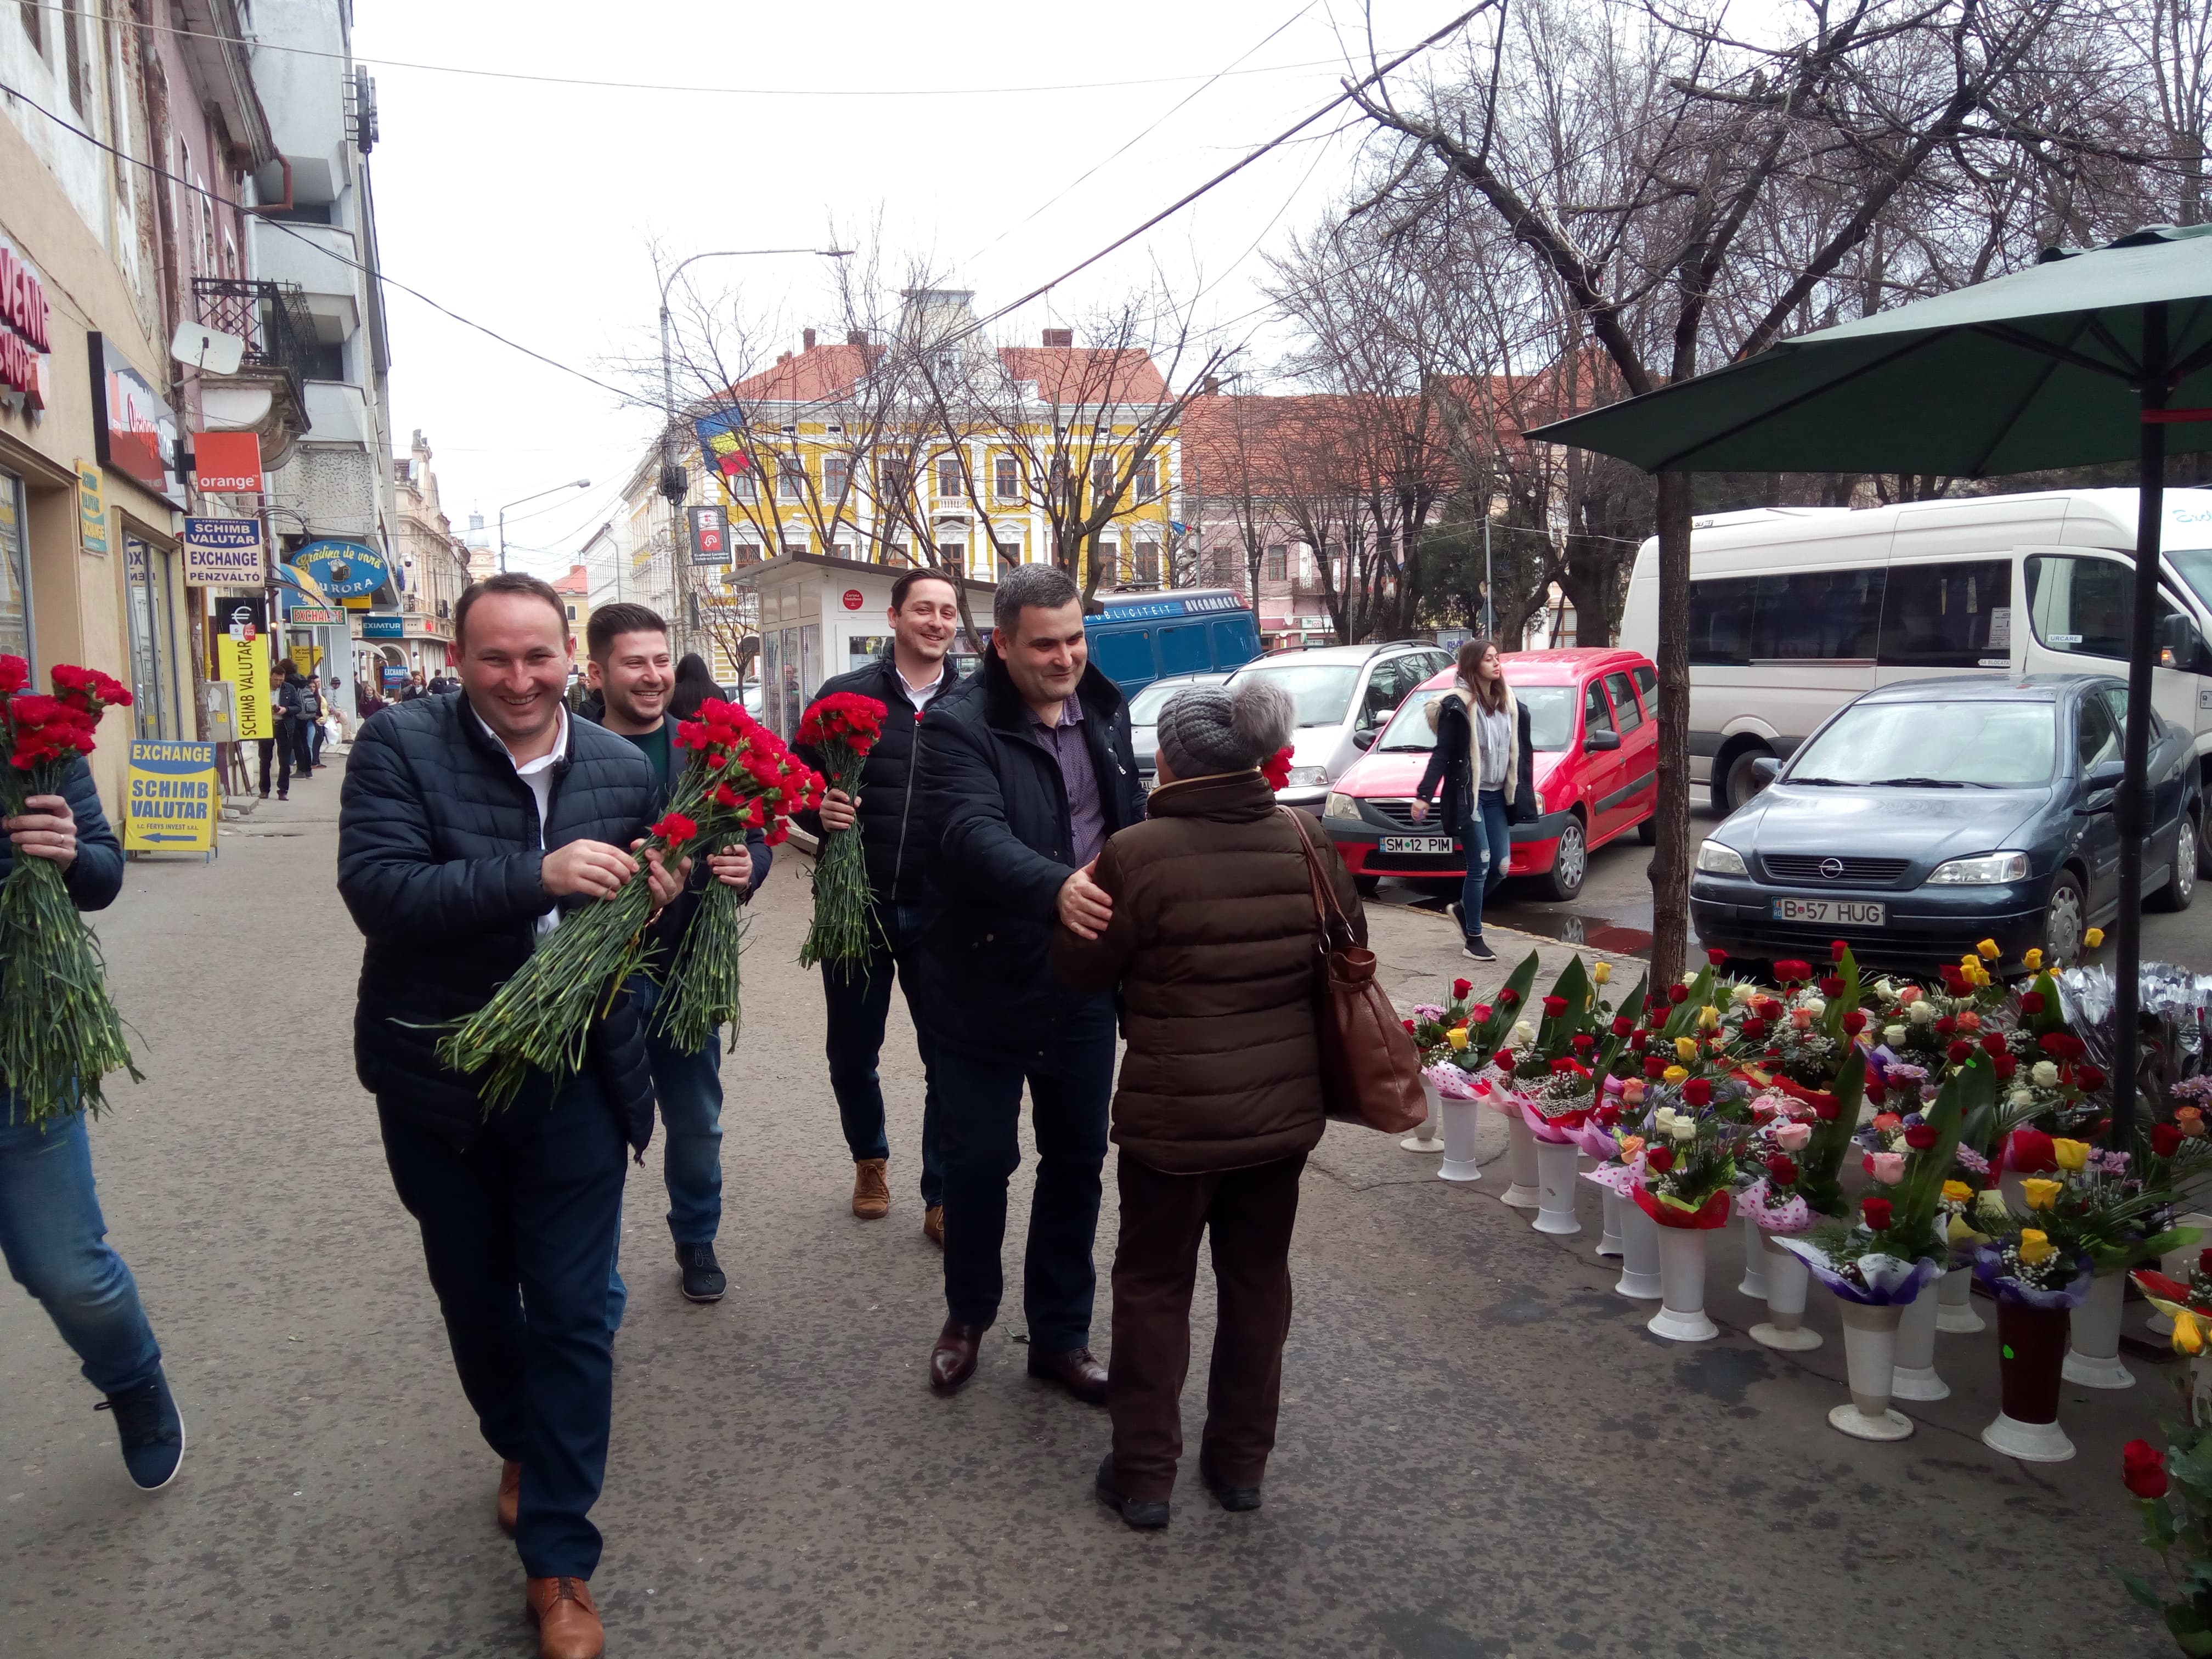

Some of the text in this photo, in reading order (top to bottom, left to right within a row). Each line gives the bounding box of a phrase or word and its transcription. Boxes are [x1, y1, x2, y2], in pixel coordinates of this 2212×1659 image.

[127, 393, 157, 460] Orange
[200, 476, 255, 489] orange
[195, 523, 250, 534] SCHIMB
[190, 534, 255, 544] VALUTAR
[190, 551, 258, 566] EXCHANGE
[343, 545, 354, 559] de
[190, 571, 260, 582] PÉNZVÁLTÓ
[318, 578, 374, 593] URORA
[294, 610, 343, 623] EXCHANE
[237, 640, 255, 691] VALUTAR
[240, 695, 257, 735] SCHIMB
[133, 744, 212, 763] EXCHANGE
[132, 779, 208, 799] SCHIMB
[131, 800, 207, 819] VALUTAR
[1386, 838, 1449, 851] SM 12 PIM
[1784, 900, 1880, 923] B 57 HUG
